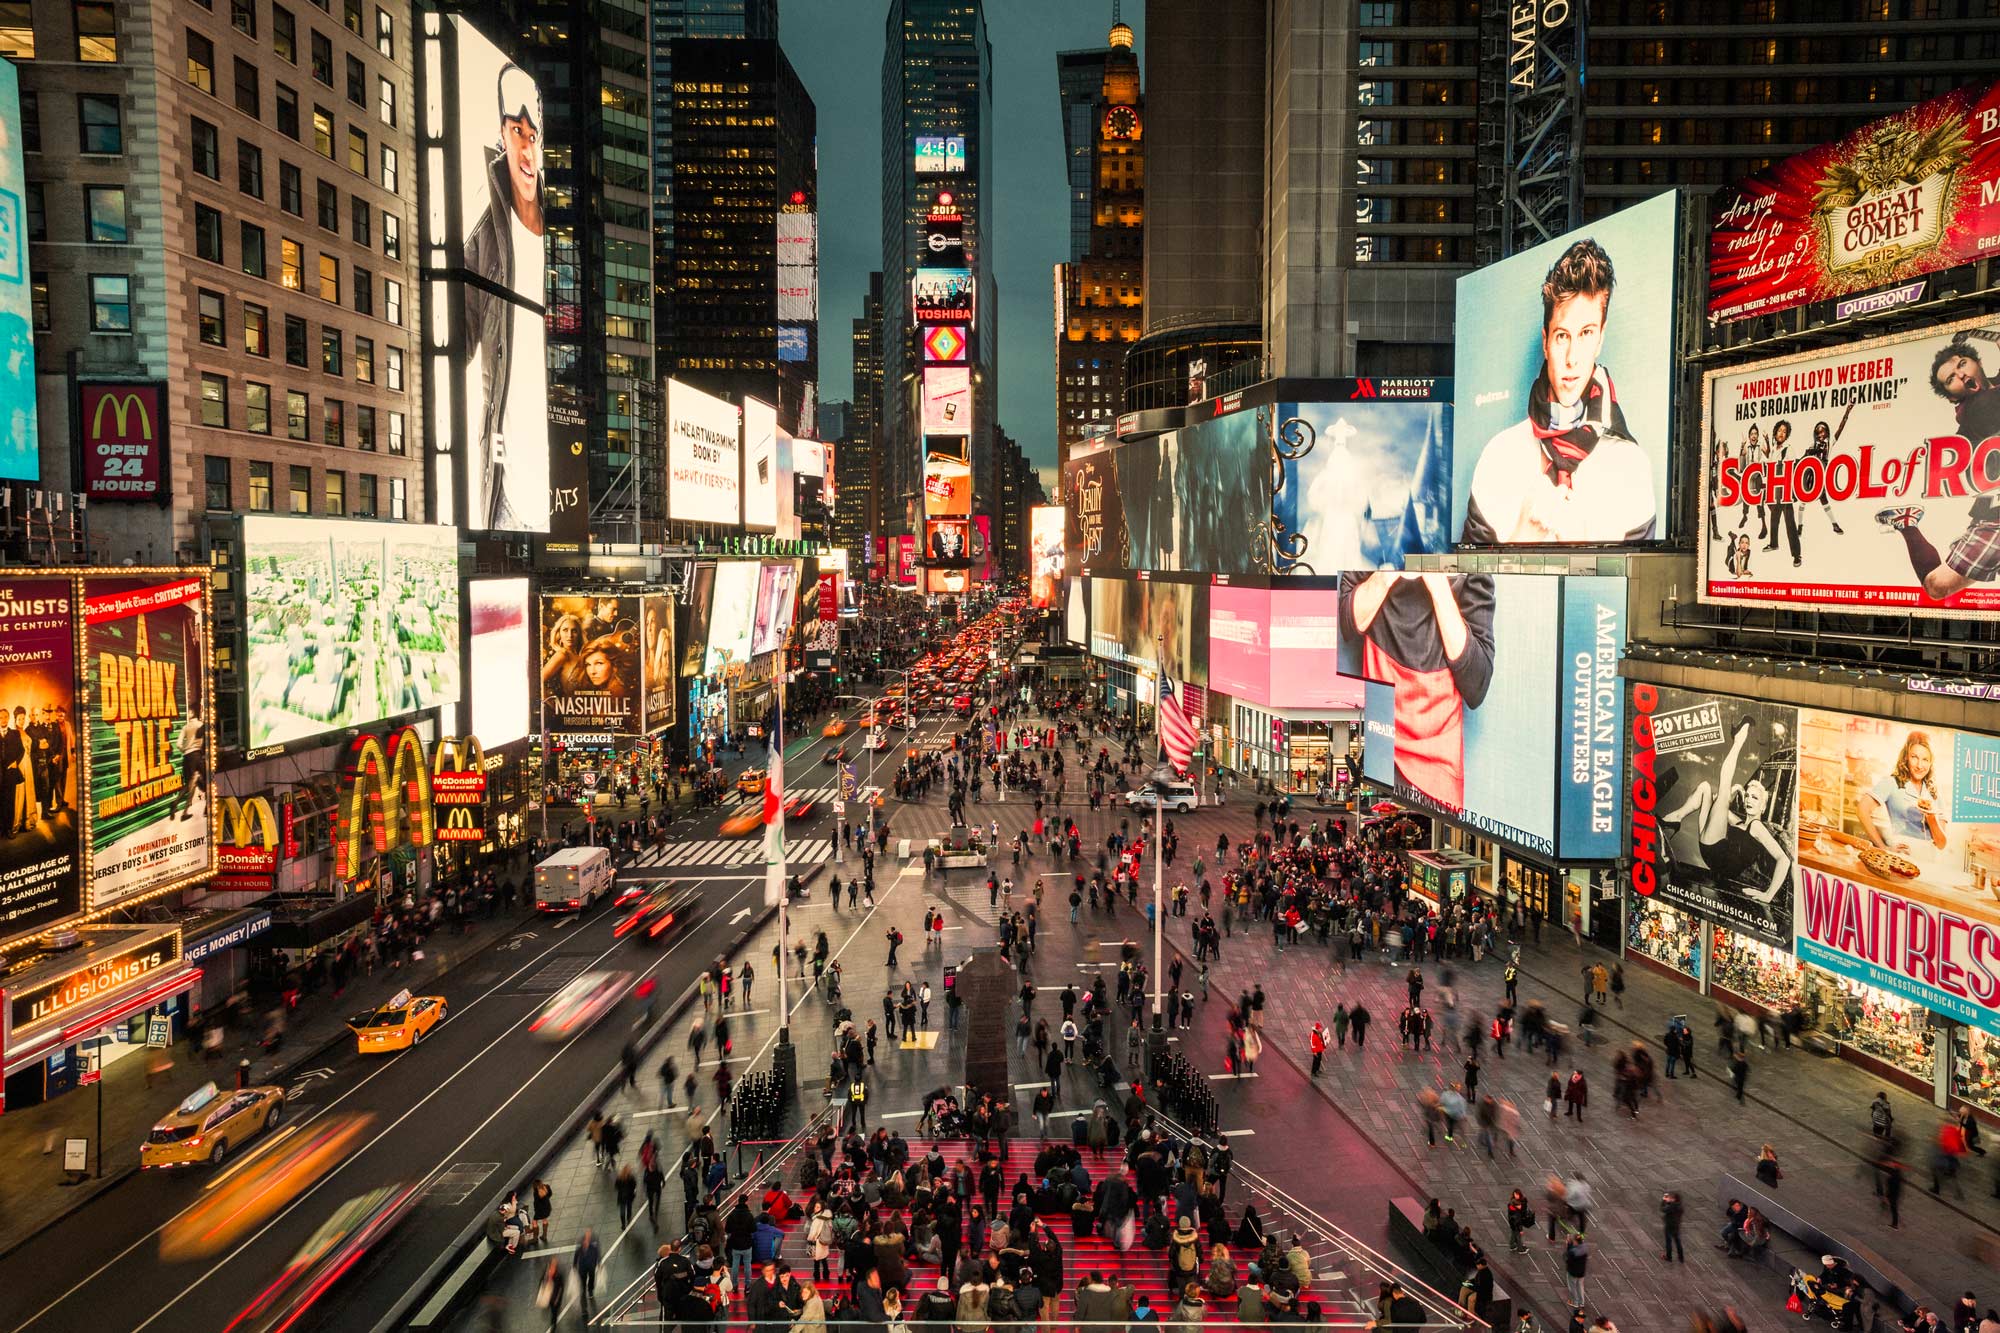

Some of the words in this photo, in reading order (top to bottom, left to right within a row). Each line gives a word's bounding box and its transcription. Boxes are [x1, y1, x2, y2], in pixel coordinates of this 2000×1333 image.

[922, 142, 958, 156] 4:50
[927, 214, 962, 222] TOSHIBA
[932, 206, 956, 214] 2017
[1715, 194, 1750, 229] Are
[1744, 192, 1777, 230] you
[1847, 186, 1923, 229] GREAT
[1728, 208, 1772, 260] ready
[1770, 220, 1783, 238] to
[1844, 208, 1924, 252] COMET
[1737, 240, 1774, 280] wake
[1868, 249, 1894, 264] 1812
[918, 309, 972, 320] TOSHIBA
[1720, 304, 1744, 318] IMPERIAL
[1744, 298, 1766, 312] THEATRE
[1845, 287, 1914, 315] OUTFRONT
[1381, 379, 1434, 387] MARRIOTT
[1794, 368, 1832, 392] LLOYD
[1838, 357, 1894, 385] WEBBER
[1381, 388, 1428, 397] MARQUIS
[1736, 402, 1757, 421] HAS
[1760, 391, 1828, 417] BROADWAY
[1872, 402, 1891, 410] REUTERS
[555, 414, 570, 422] THAN
[680, 420, 736, 451] HEARTWARMING
[96, 444, 148, 456] OPEN
[694, 444, 712, 462] BOOK
[713, 450, 720, 463] BY
[104, 458, 144, 477] 24
[674, 467, 702, 484] HARVEY
[1719, 445, 1888, 507] SCHOOL
[1882, 447, 1926, 497] of
[92, 480, 156, 492] HOURS
[1076, 470, 1102, 518] BEAUTY
[1081, 515, 1103, 563] BEAST
[86, 604, 98, 615] The
[99, 602, 115, 612] New
[116, 599, 133, 612] York
[133, 596, 154, 608] Times
[185, 582, 200, 596] PICK
[1791, 588, 1810, 597] WINTER
[1812, 588, 1834, 598] GARDEN
[1835, 589, 1859, 599] THEATRE
[1886, 592, 1920, 601] BROADWAY
[136, 613, 150, 658] A
[100, 652, 178, 721] BRONX
[1594, 604, 1616, 745] AMERICAN
[555, 697, 632, 716] NASHVILLE
[1572, 652, 1592, 784] OUTFITTERS
[604, 716, 624, 726] CMT
[1654, 718, 1673, 736] 20
[1673, 708, 1718, 730] YEARS
[560, 734, 614, 743] LUGGAGE
[114, 718, 173, 789] TALE
[434, 777, 484, 785] McDonald's
[1592, 748, 1615, 833] EAGLE
[1632, 682, 1658, 896] CHICAGO
[1971, 773, 1984, 795] OF
[1393, 784, 1445, 813] AMERICAN
[1444, 802, 1478, 828] EAGLE
[1480, 816, 1553, 854] OUTFITTERS
[133, 836, 170, 856] COMBINATION
[220, 854, 274, 864] cDonald's
[4, 864, 38, 881] GOLDEN
[40, 858, 56, 871] AGE
[58, 855, 70, 866] OF
[94, 862, 120, 880] JERSEY
[122, 856, 141, 871] BOYS
[169, 843, 183, 856] SIDE
[7, 880, 24, 892] ALL
[25, 872, 45, 886] NEW
[46, 864, 71, 878] SHOW
[17, 903, 36, 916] Palace
[37, 898, 58, 909] Theatre
[1666, 884, 1778, 932] CHICAGOTHEMUSICAL.COM
[184, 944, 208, 962] NGE
[209, 928, 246, 952] MONEY
[250, 918, 271, 934] ATM
[1802, 868, 2000, 1008] WAITRES
[92, 960, 114, 976] THE
[31, 952, 162, 1020] ILLUSIONISTS
